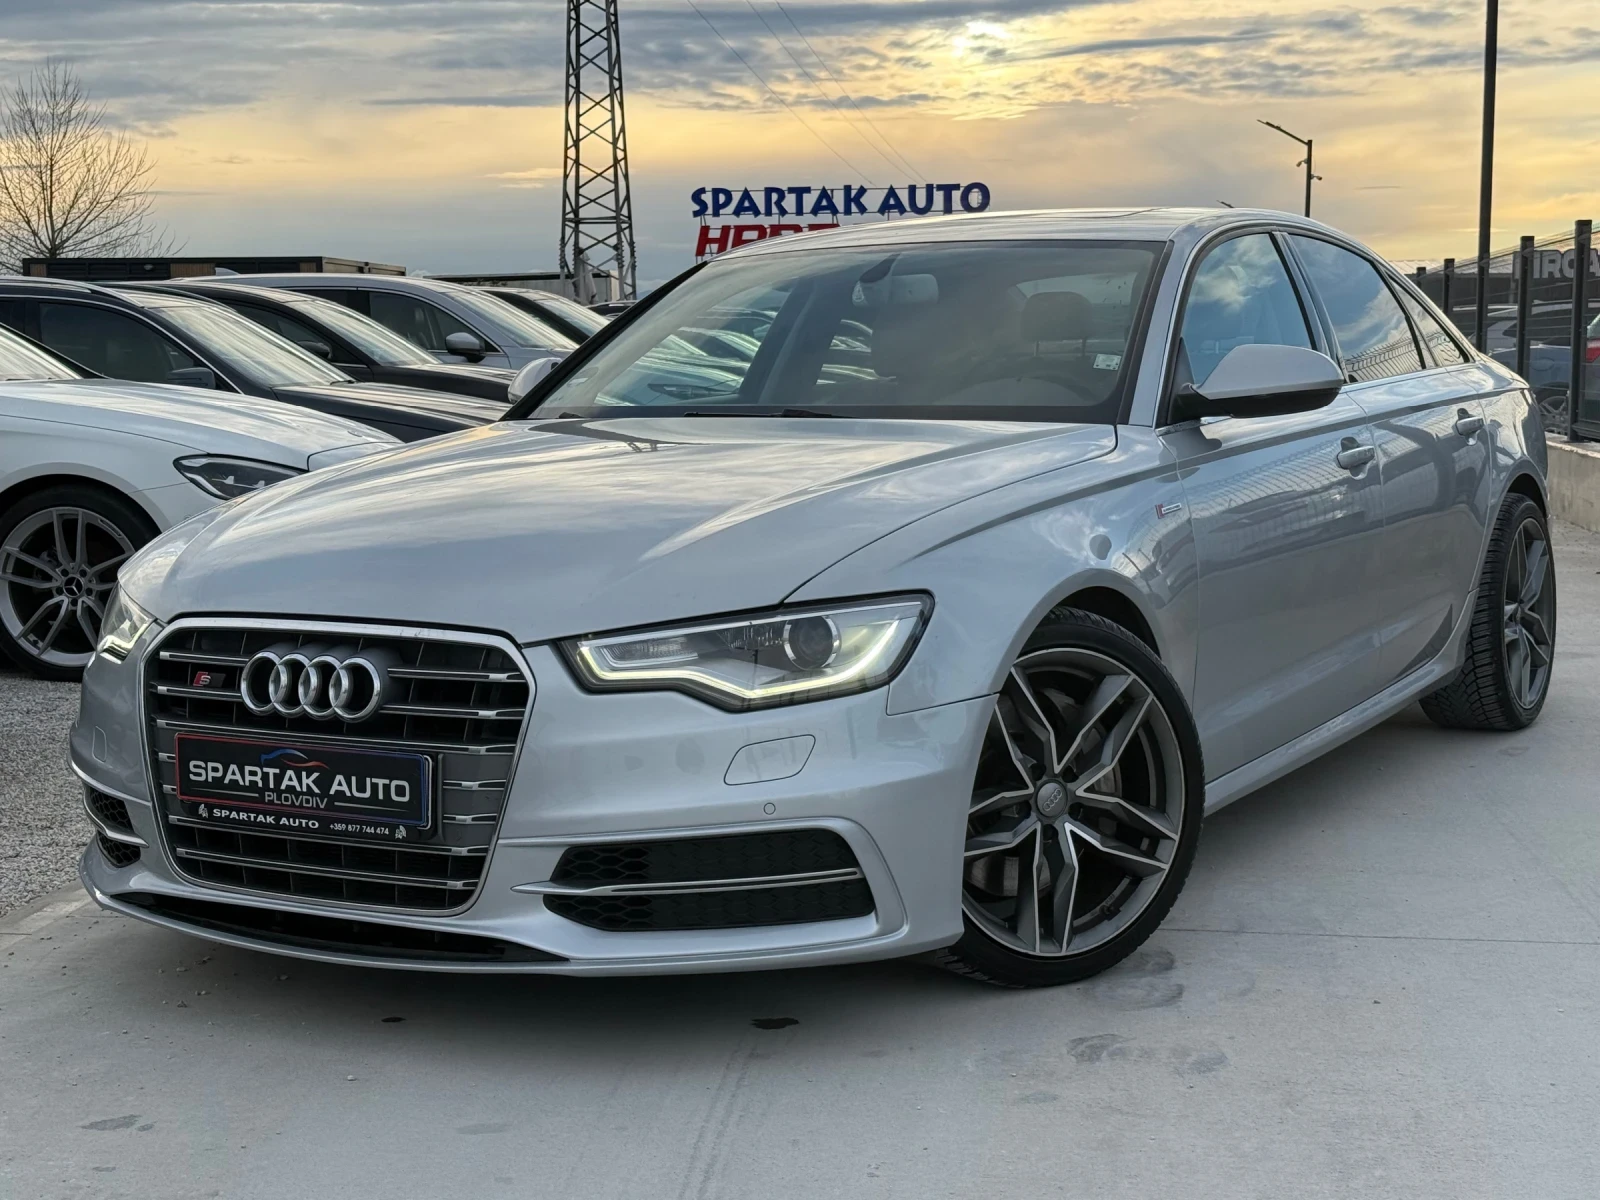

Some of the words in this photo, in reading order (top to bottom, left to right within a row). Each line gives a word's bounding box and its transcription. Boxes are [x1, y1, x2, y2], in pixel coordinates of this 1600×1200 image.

[691, 184, 868, 218] SPARTAK
[877, 182, 991, 215] AUTO
[189, 760, 321, 794] SPARTAK
[329, 774, 410, 803] AUTO
[265, 791, 328, 809] PLOVDIV
[212, 808, 276, 824] SPARTAK
[279, 817, 319, 829] AUTO
[329, 822, 346, 831] +359
[362, 825, 375, 834] 744
[376, 827, 389, 835] 474
